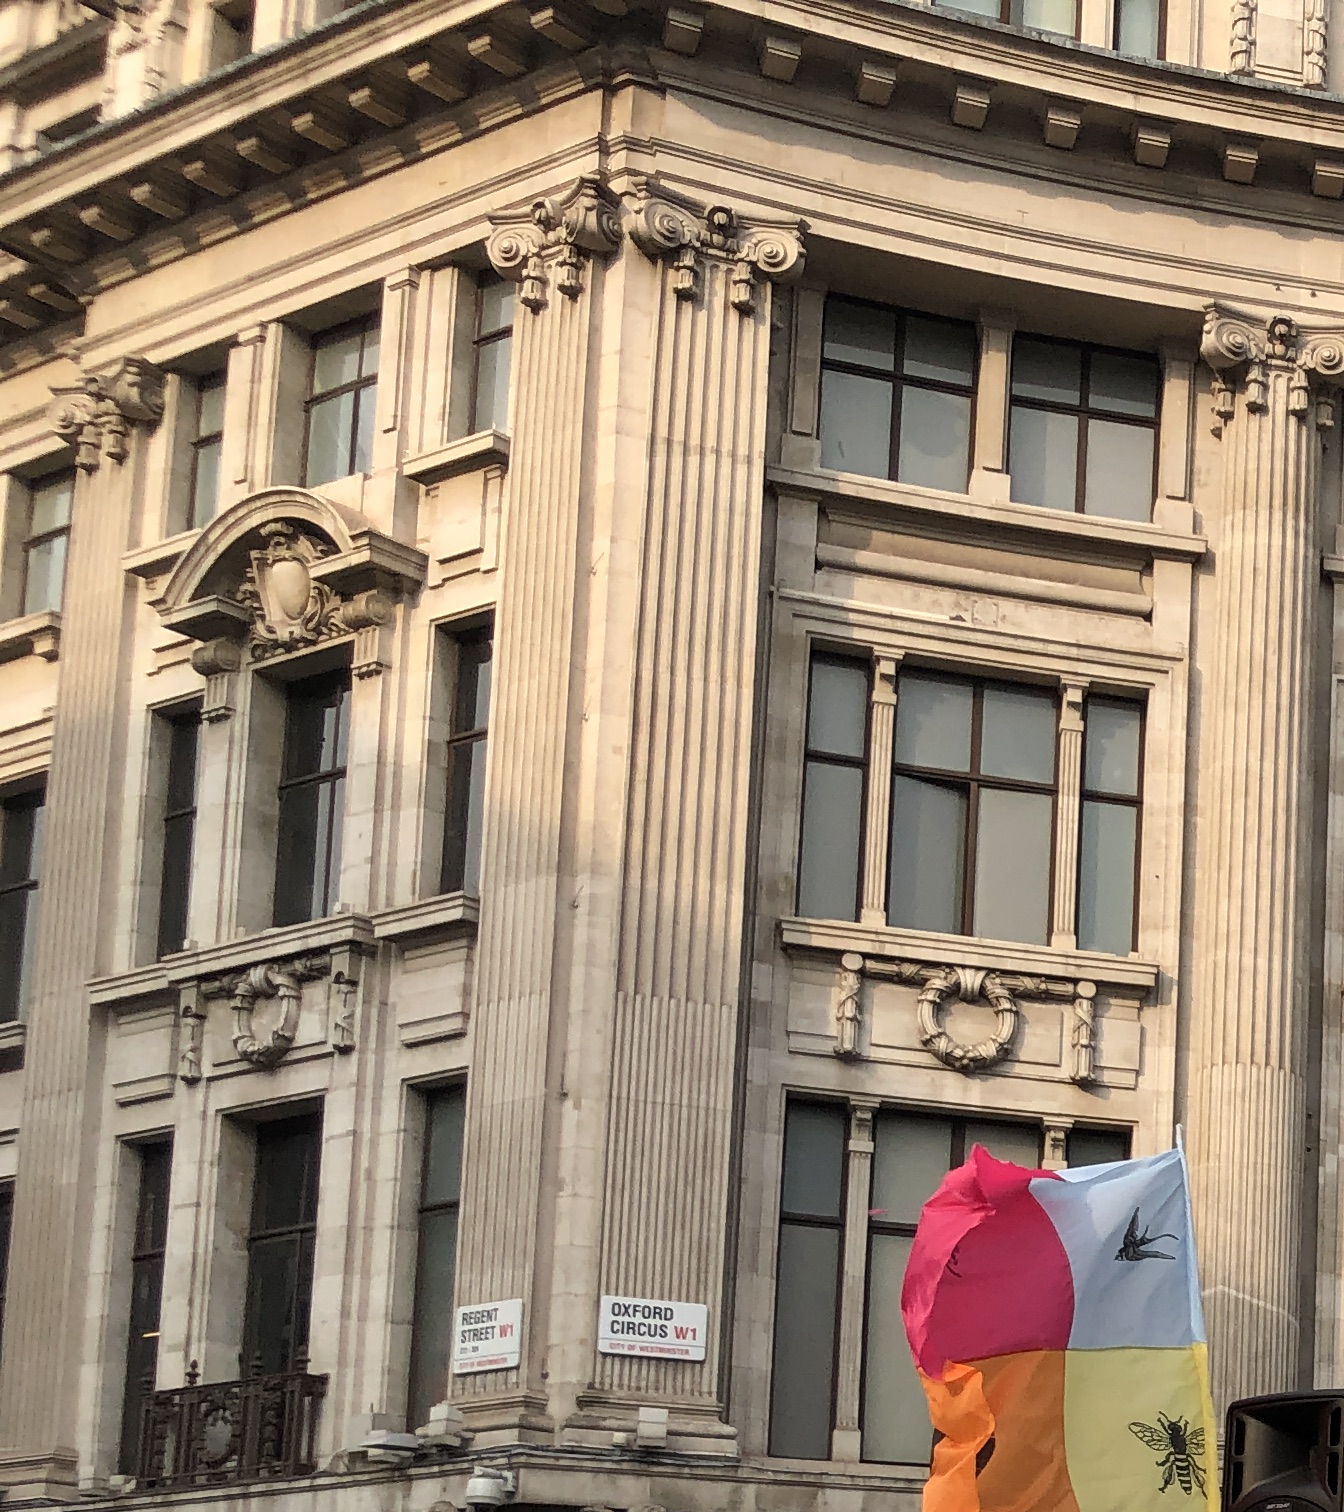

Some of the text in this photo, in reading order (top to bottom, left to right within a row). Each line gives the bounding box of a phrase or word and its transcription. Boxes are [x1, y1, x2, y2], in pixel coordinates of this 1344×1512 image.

[462, 1308, 499, 1326] REGENT
[611, 1302, 674, 1321] OXFORD
[461, 1323, 514, 1343] STREET W1
[610, 1320, 697, 1341] CIRCUS W1
